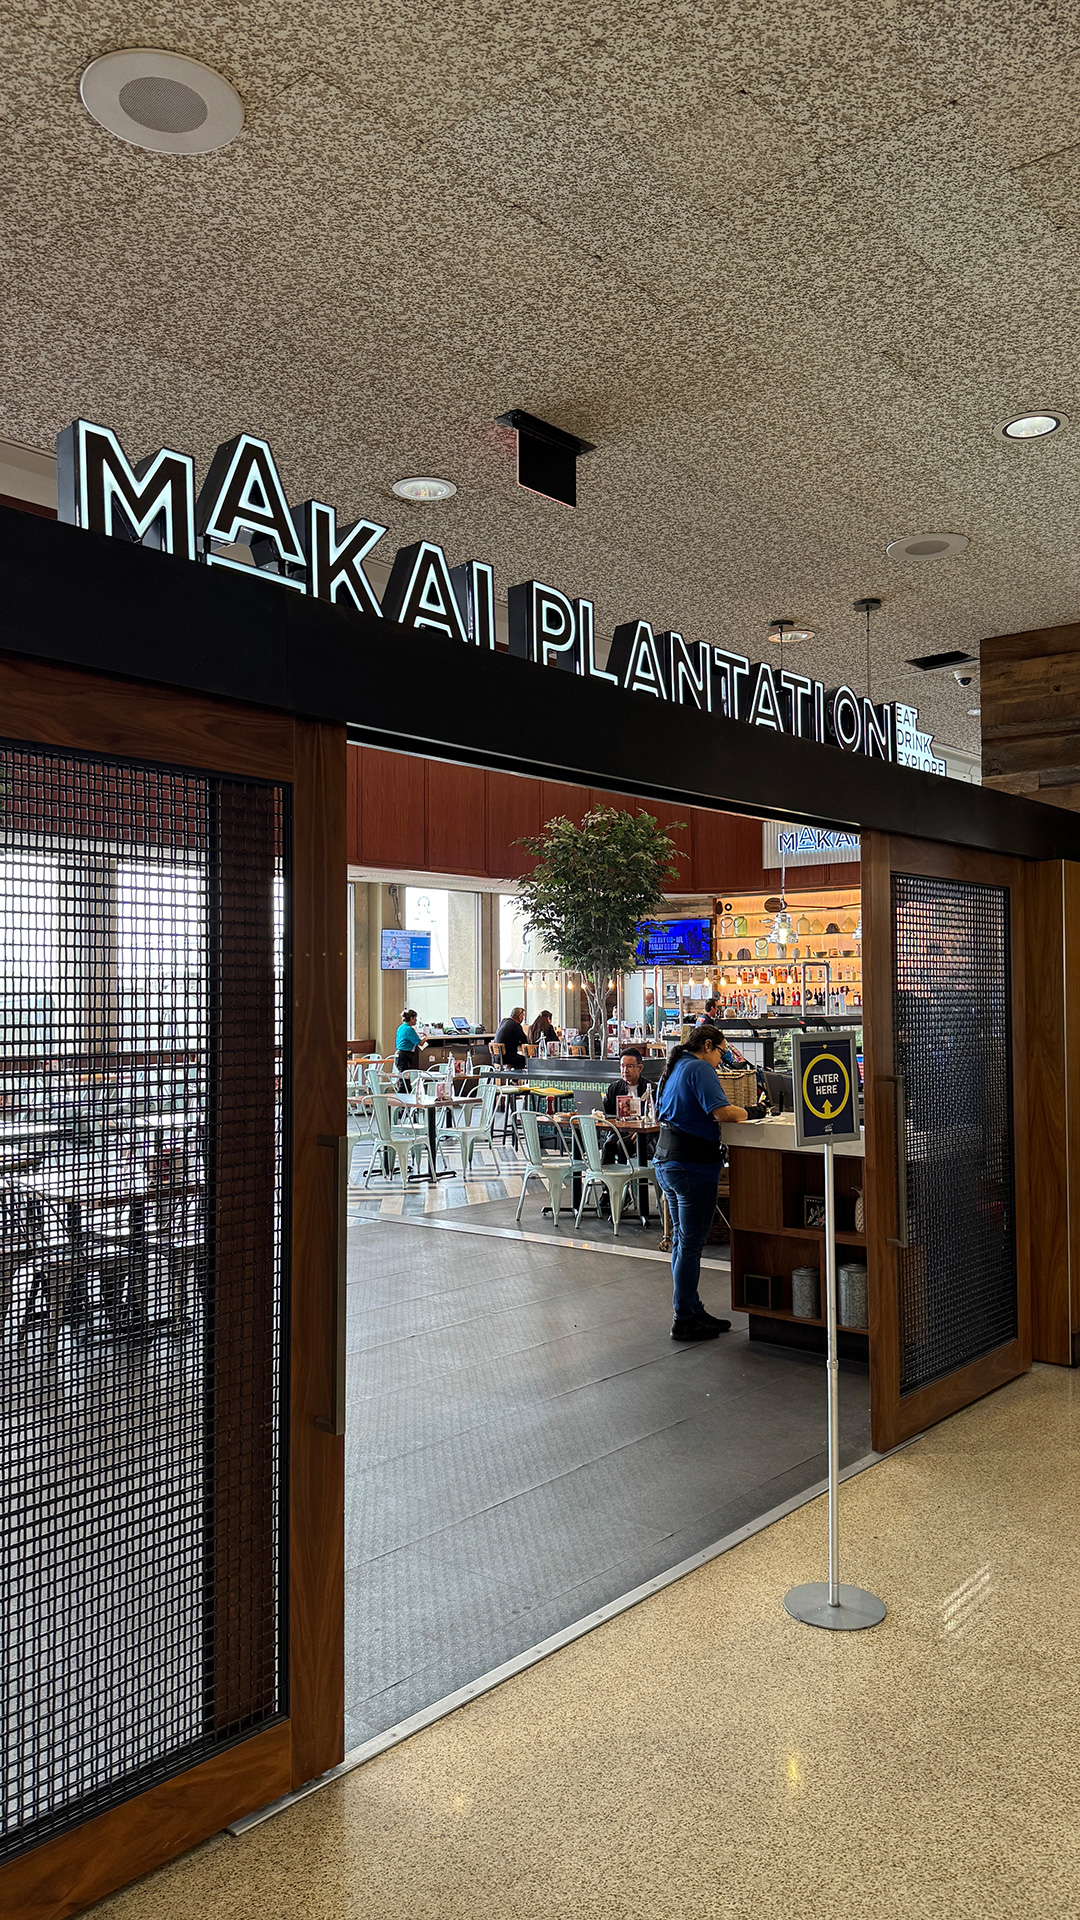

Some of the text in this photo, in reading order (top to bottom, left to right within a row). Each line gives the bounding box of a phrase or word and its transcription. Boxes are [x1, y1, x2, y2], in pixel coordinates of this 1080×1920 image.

[76, 418, 893, 763] MAKAI PLANTATION
[896, 705, 916, 728] EAT
[897, 728, 931, 755] DRINK
[778, 826, 860, 853] MAKAI
[813, 1073, 839, 1084] ENTER
[815, 1084, 838, 1096] HERE
